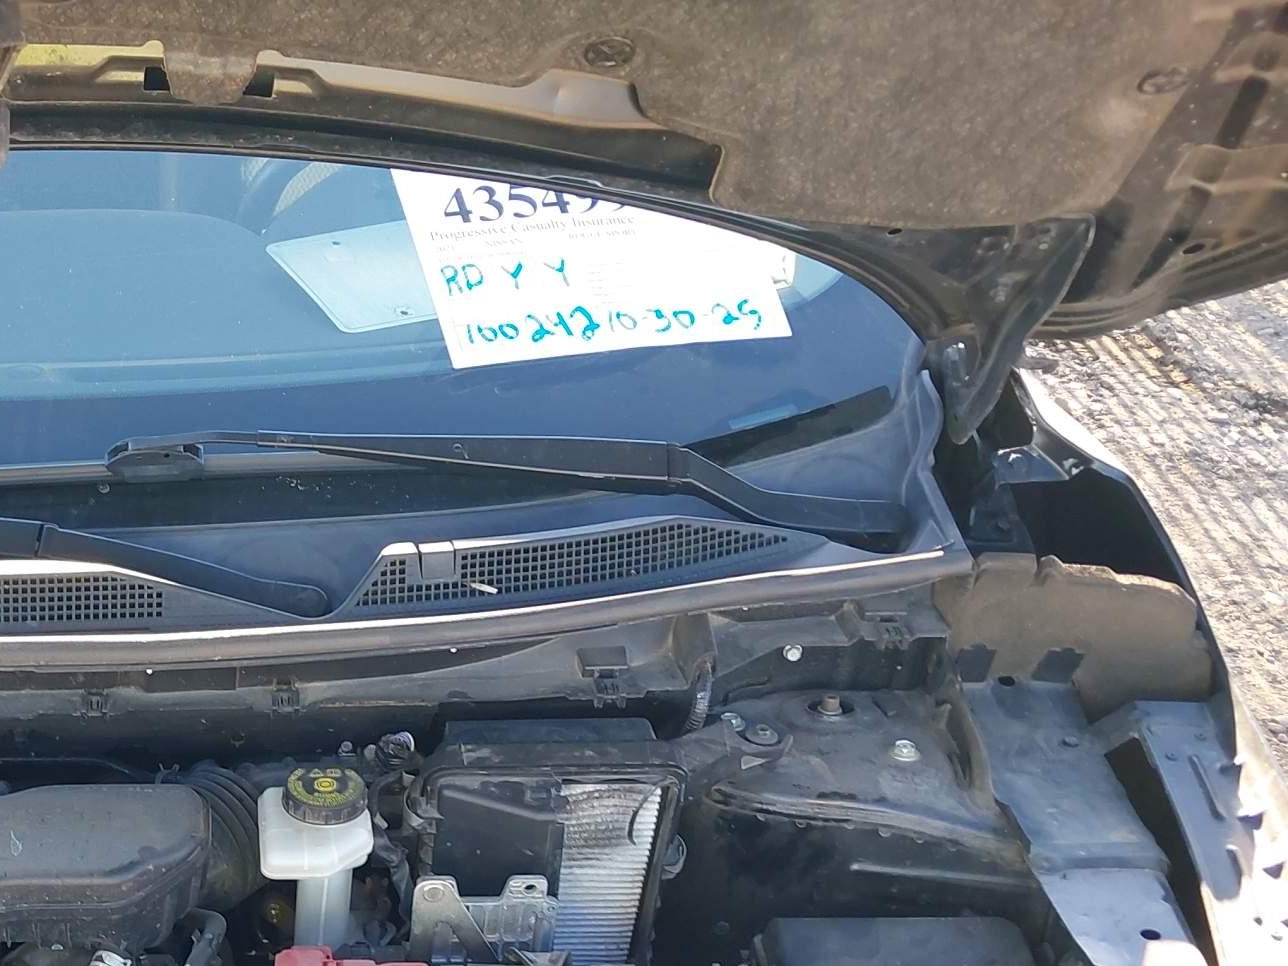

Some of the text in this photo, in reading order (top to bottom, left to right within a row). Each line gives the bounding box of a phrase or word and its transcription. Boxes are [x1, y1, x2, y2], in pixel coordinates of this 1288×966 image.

[430, 216, 635, 241] Progressive Casualty Insurance
[440, 263, 483, 296] RD
